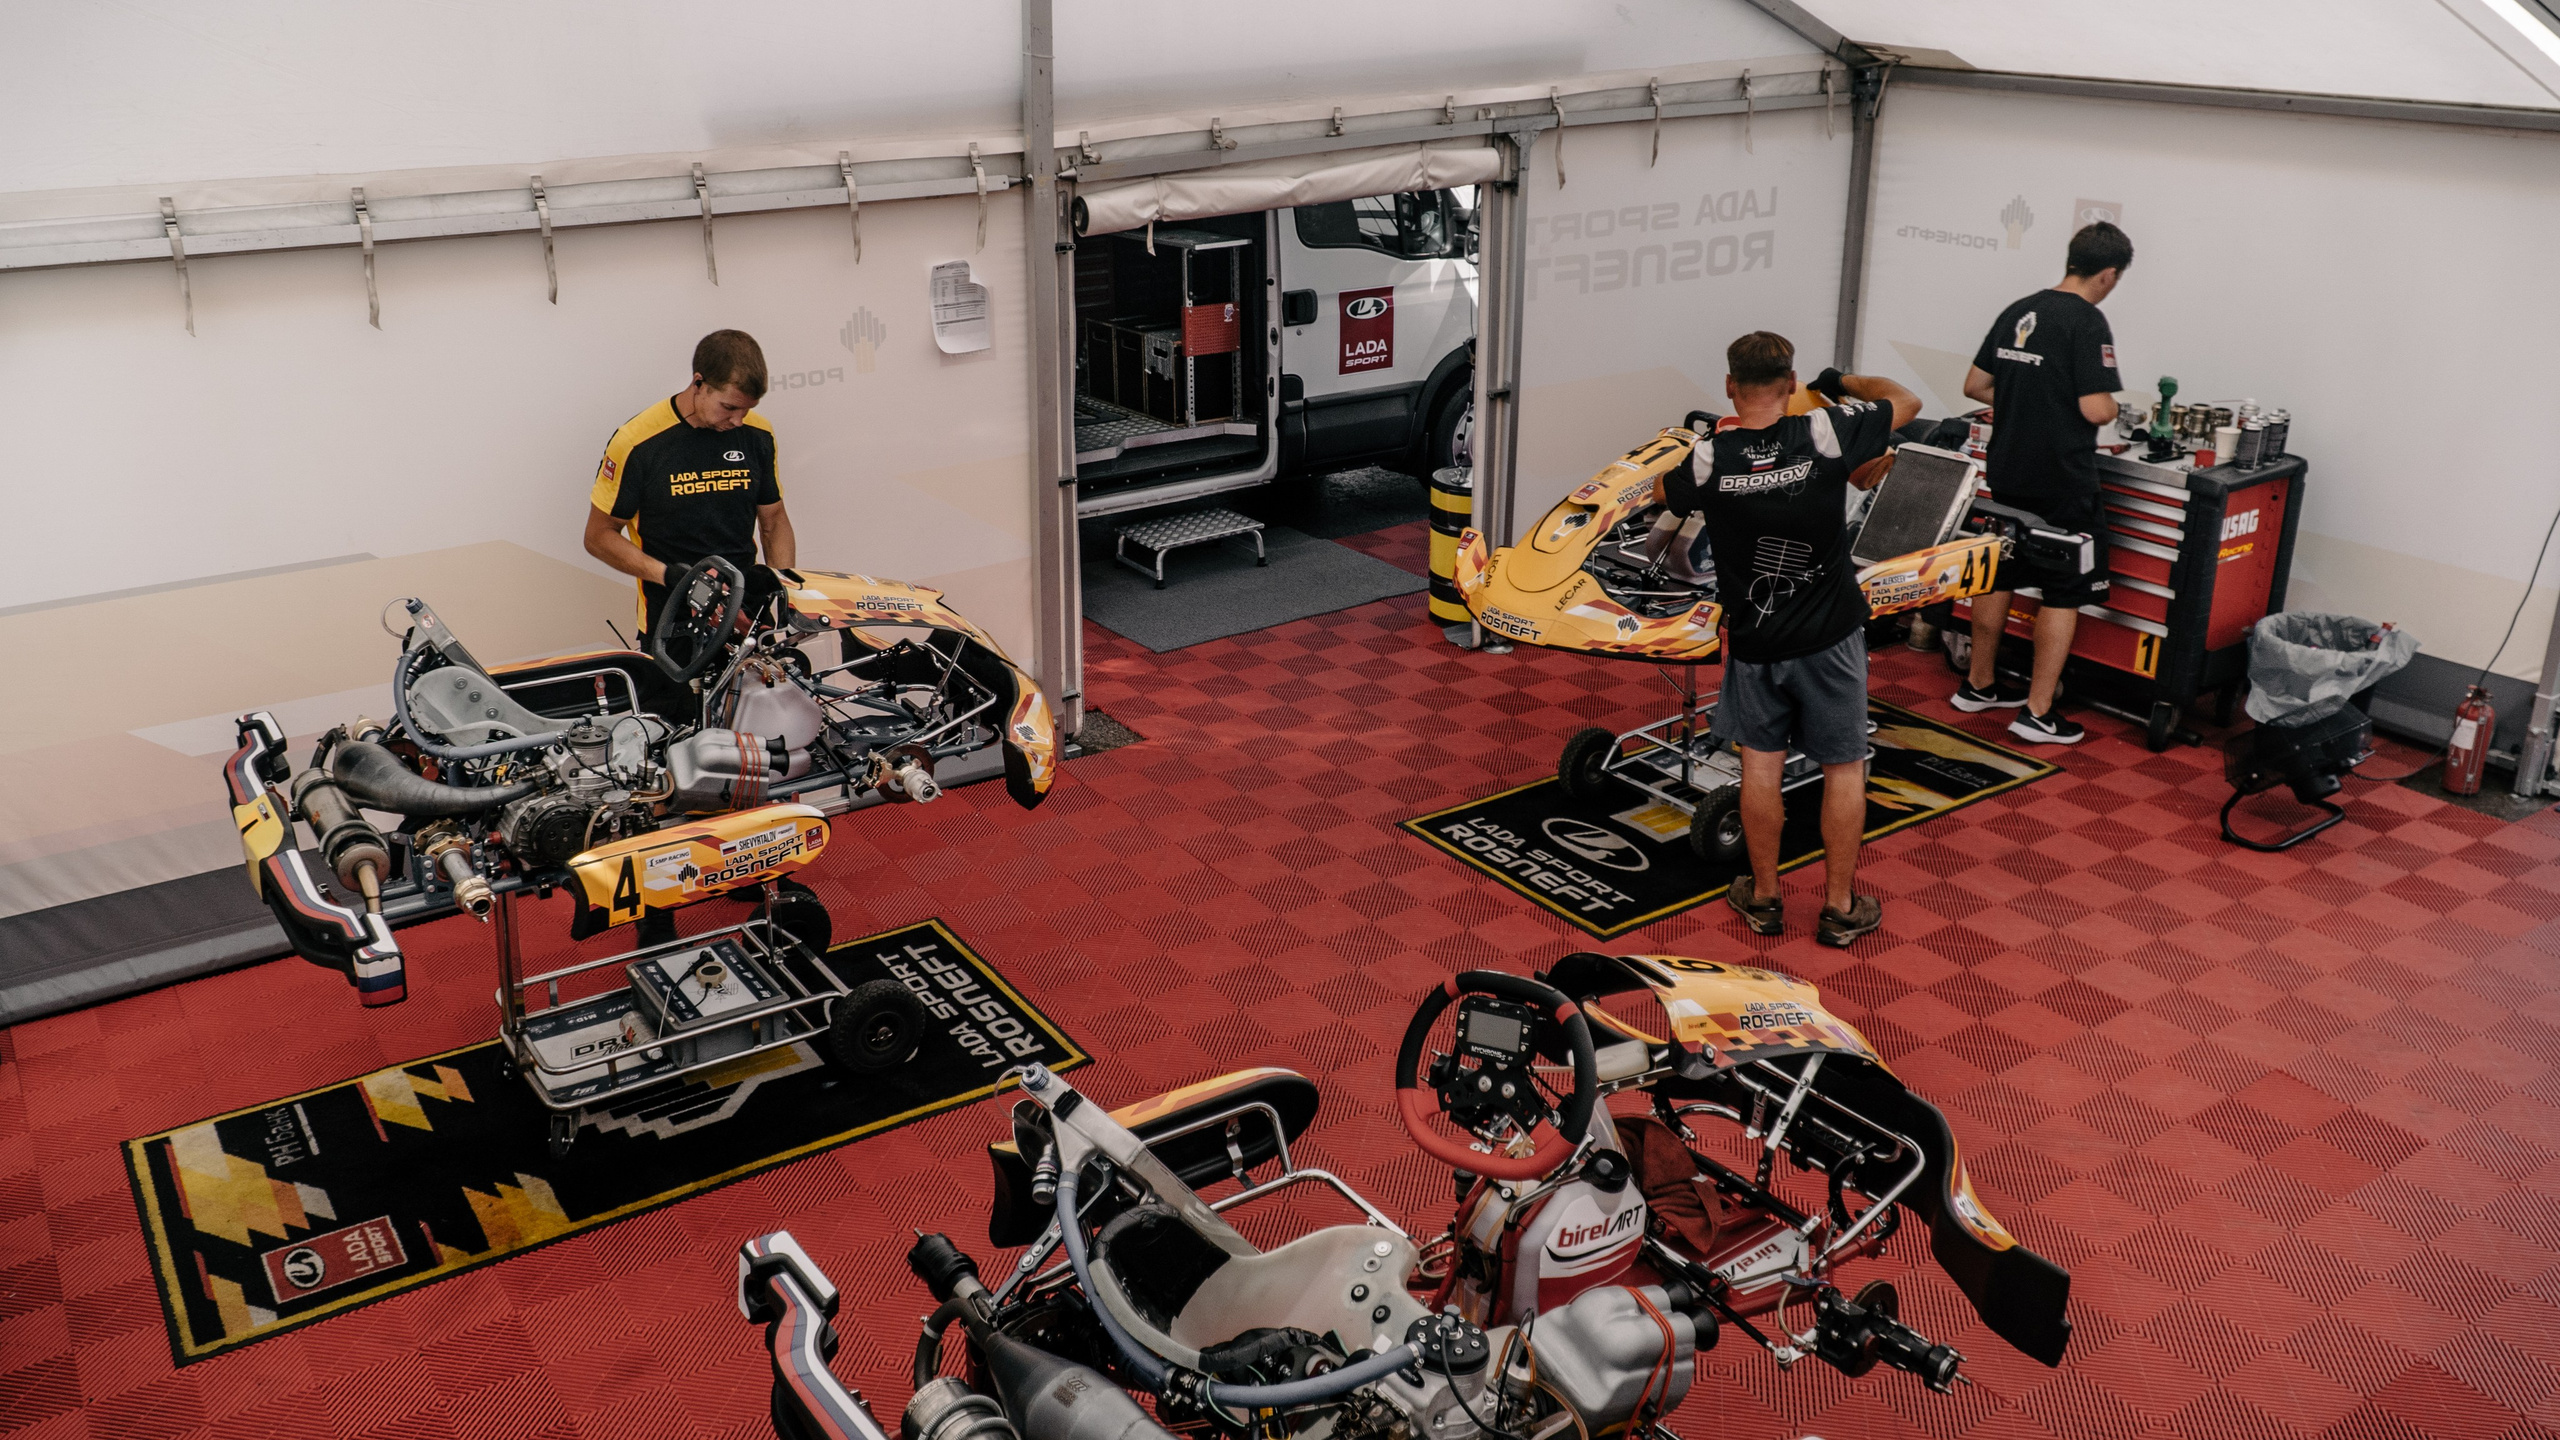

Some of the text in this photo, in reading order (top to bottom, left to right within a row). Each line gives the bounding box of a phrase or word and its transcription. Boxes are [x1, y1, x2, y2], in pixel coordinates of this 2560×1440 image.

[1345, 339, 1388, 357] LADA
[1345, 354, 1388, 367] SPORT
[670, 469, 750, 483] LADA SPORT
[670, 479, 751, 497] ROSNEFT
[1635, 473, 1659, 487] SPOR
[1721, 462, 1810, 490] DRONOV
[1617, 482, 1655, 505] ROSNE
[2220, 509, 2260, 542] USAG
[1485, 554, 1502, 588] LECAR
[1959, 546, 1991, 595] 41
[1554, 578, 1587, 611] LECAR
[1871, 586, 1935, 606] ROSNEFT
[1872, 588, 1891, 596] LADA
[1894, 582, 1924, 593] SPORT
[856, 601, 924, 611] ROSNEFT
[1487, 605, 1536, 627] LADA SPORT
[1480, 611, 1542, 641] ROSNEFT
[725, 834, 803, 867] LADA SPORT
[738, 830, 777, 851] SHEVYRTALOV
[655, 851, 690, 865] SMP RACING
[704, 843, 804, 887] ROSNEFT
[1440, 824, 1615, 912] ROSNEFT
[1467, 817, 1636, 903] LADA SPORT
[612, 855, 641, 917] 4
[876, 953, 1007, 1068] LADA SPORT
[903, 944, 1045, 1058] ROSNEFT
[1745, 1002, 1802, 1012] LADA SPORT
[1739, 1012, 1815, 1030] ROSNEFT
[1557, 1203, 1643, 1248] birelART
[342, 1229, 375, 1272] LADA
[363, 1226, 394, 1264] SPORT
